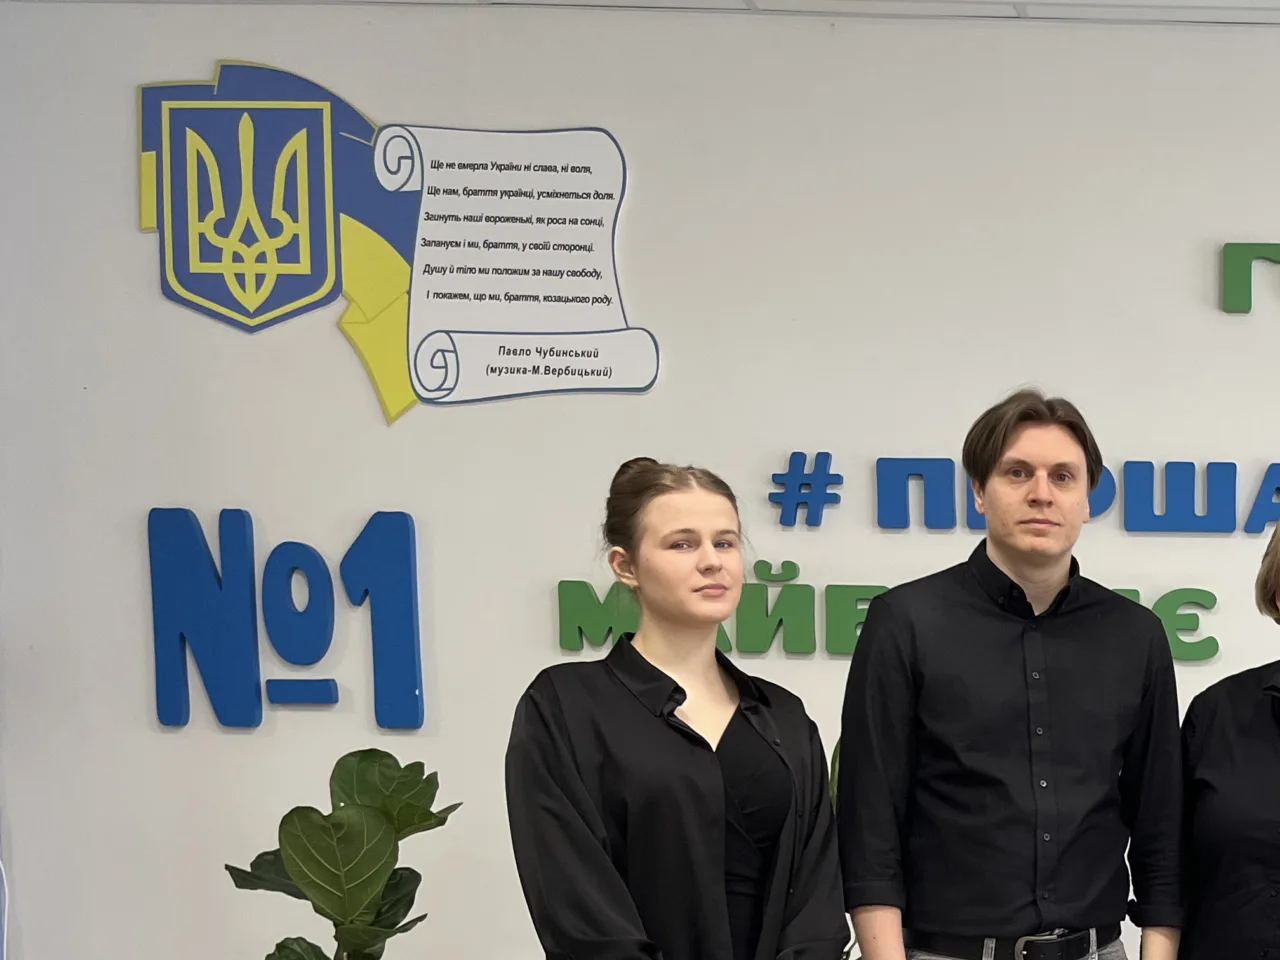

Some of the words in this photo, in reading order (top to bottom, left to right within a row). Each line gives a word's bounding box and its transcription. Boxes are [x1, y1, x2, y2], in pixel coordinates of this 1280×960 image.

[430, 160, 444, 170] Ще
[446, 162, 456, 170] не
[457, 162, 488, 172] вмерла
[490, 161, 522, 173] України
[523, 163, 532, 171] ні
[533, 164, 559, 174] слава,
[561, 163, 569, 172] ні
[570, 166, 593, 175] воля,
[427, 186, 441, 197] Ще
[442, 187, 461, 197] нам,
[462, 187, 498, 198] браття
[500, 188, 535, 200] українці,
[537, 190, 591, 200] усміхнеться
[593, 190, 615, 200] доля.
[424, 212, 461, 224] Згинуть
[463, 213, 483, 223] наші
[536, 216, 546, 224] як
[547, 217, 567, 226] роса
[568, 217, 579, 225] на
[580, 217, 605, 228] сонці,
[463, 239, 466, 248] і
[467, 240, 481, 250] ми,
[482, 239, 520, 251] браття,
[522, 243, 527, 252] у
[529, 241, 551, 251] своїй
[552, 242, 595, 253] сторонці.
[422, 263, 448, 275] Душу
[449, 264, 455, 274] й
[456, 265, 477, 275] тіло
[478, 266, 490, 275] ми
[491, 267, 530, 276] положим
[531, 268, 541, 277] за
[542, 269, 565, 279] нашу
[566, 268, 603, 280] свободу,
[433, 291, 472, 301] покажем,
[473, 292, 487, 302] що
[488, 293, 503, 302] ми,
[504, 291, 541, 303] браття,
[543, 294, 590, 305] козацького
[591, 294, 613, 306] роду.
[498, 345, 532, 357] Павло
[535, 346, 599, 360] Чубинський
